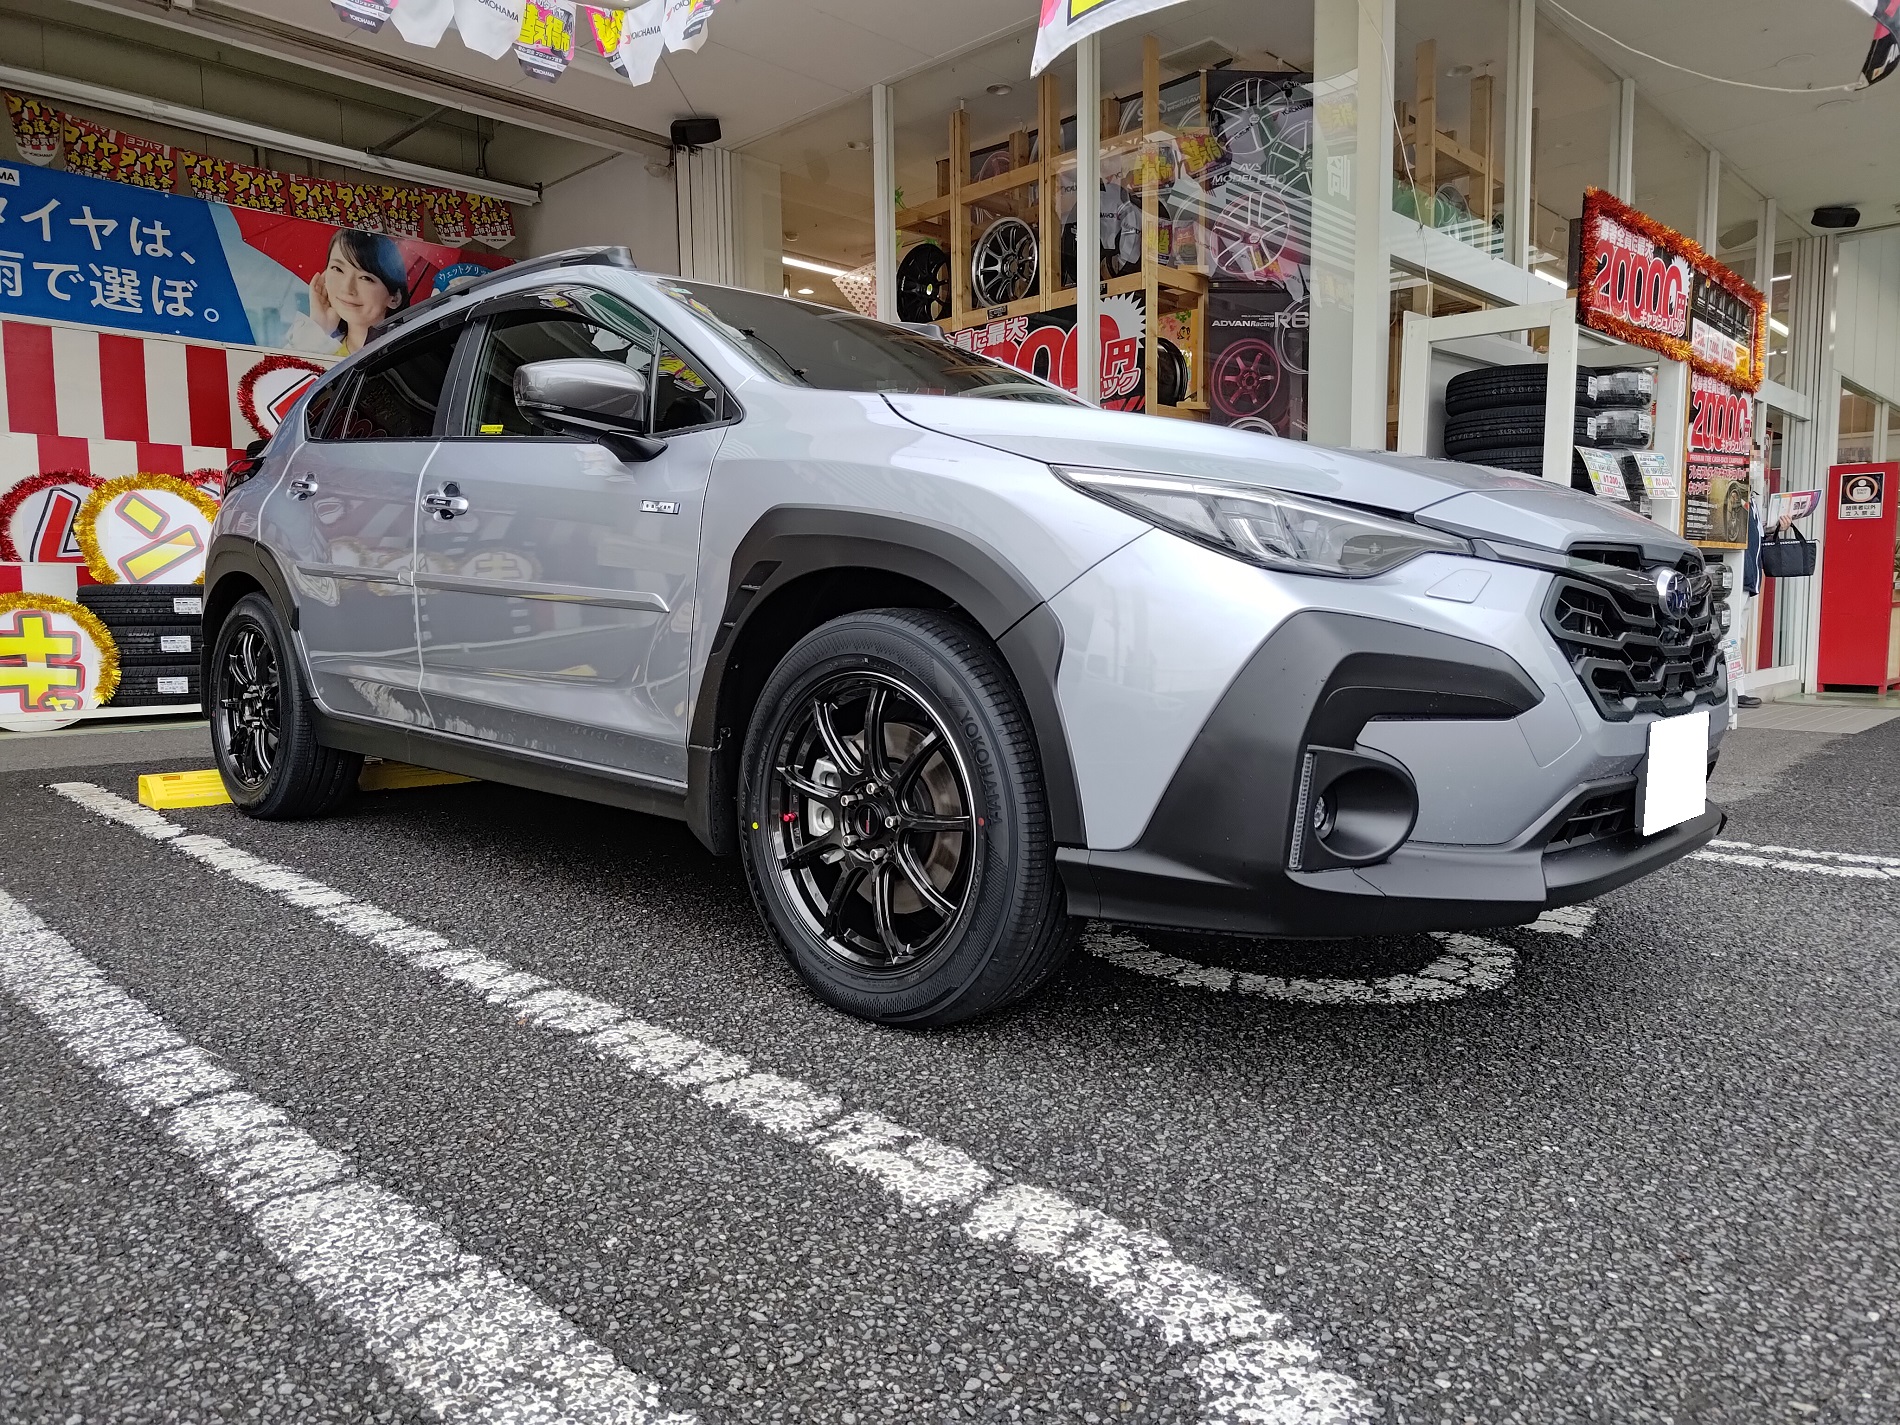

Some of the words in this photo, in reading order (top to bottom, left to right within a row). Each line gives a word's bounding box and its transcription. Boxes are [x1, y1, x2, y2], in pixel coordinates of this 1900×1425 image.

[350, 14, 377, 27] YOKOHAMA
[631, 25, 661, 39] YOKOHAMA
[532, 68, 556, 78] YOKOHAMA
[64, 121, 119, 157] タイヤ
[127, 135, 164, 151] ヨコハマ
[119, 146, 175, 174] タイヤ
[231, 169, 285, 193] タイヤ
[958, 709, 1003, 826] YOKOHAMA
